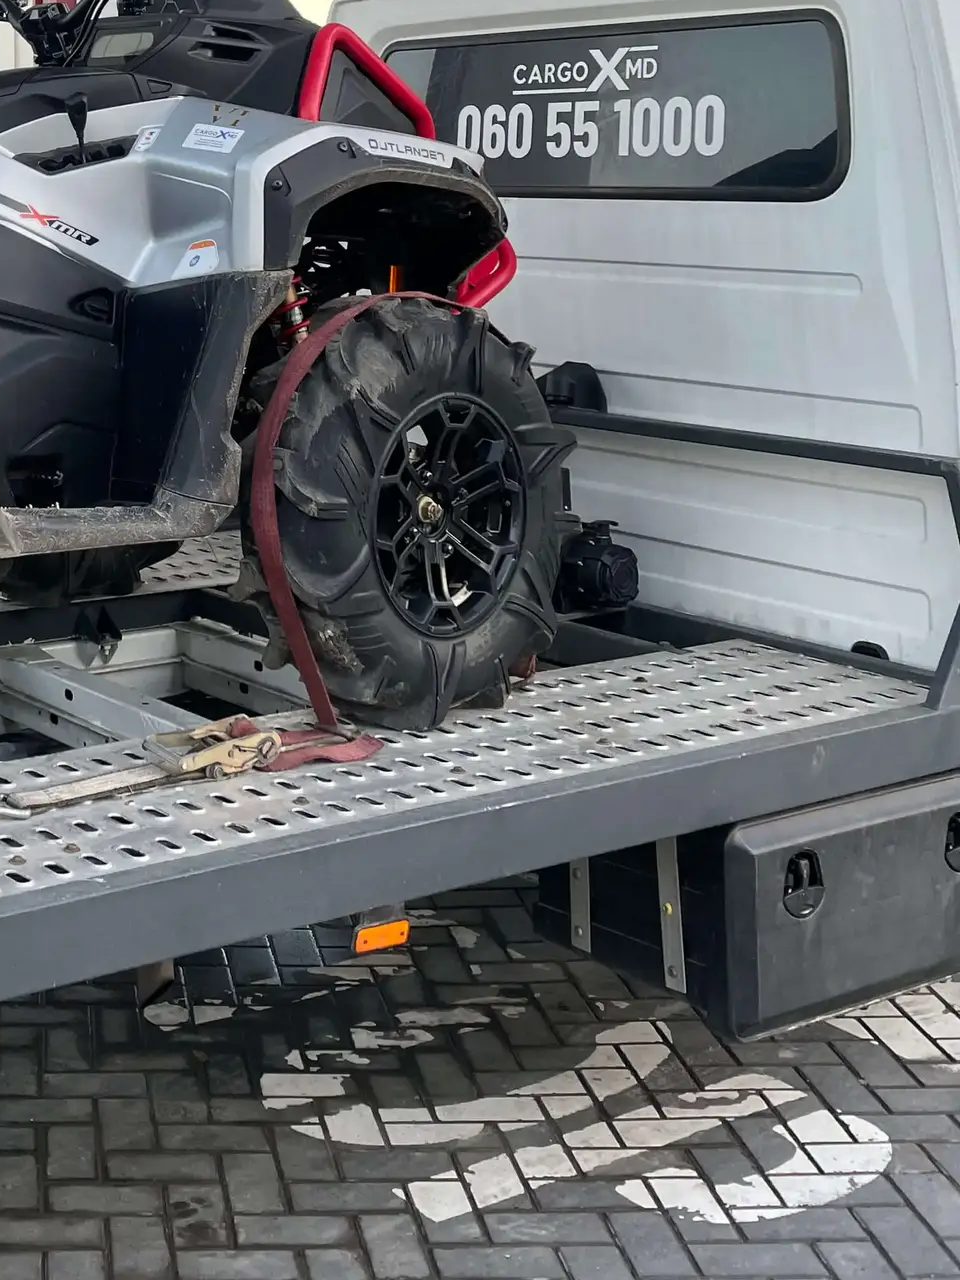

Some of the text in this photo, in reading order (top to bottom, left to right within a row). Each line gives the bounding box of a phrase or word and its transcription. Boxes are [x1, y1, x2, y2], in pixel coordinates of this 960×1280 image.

[513, 61, 589, 84] CARGO
[626, 58, 658, 79] MD
[457, 94, 726, 158] 060 55 1000
[368, 138, 445, 162] OUTLANDER
